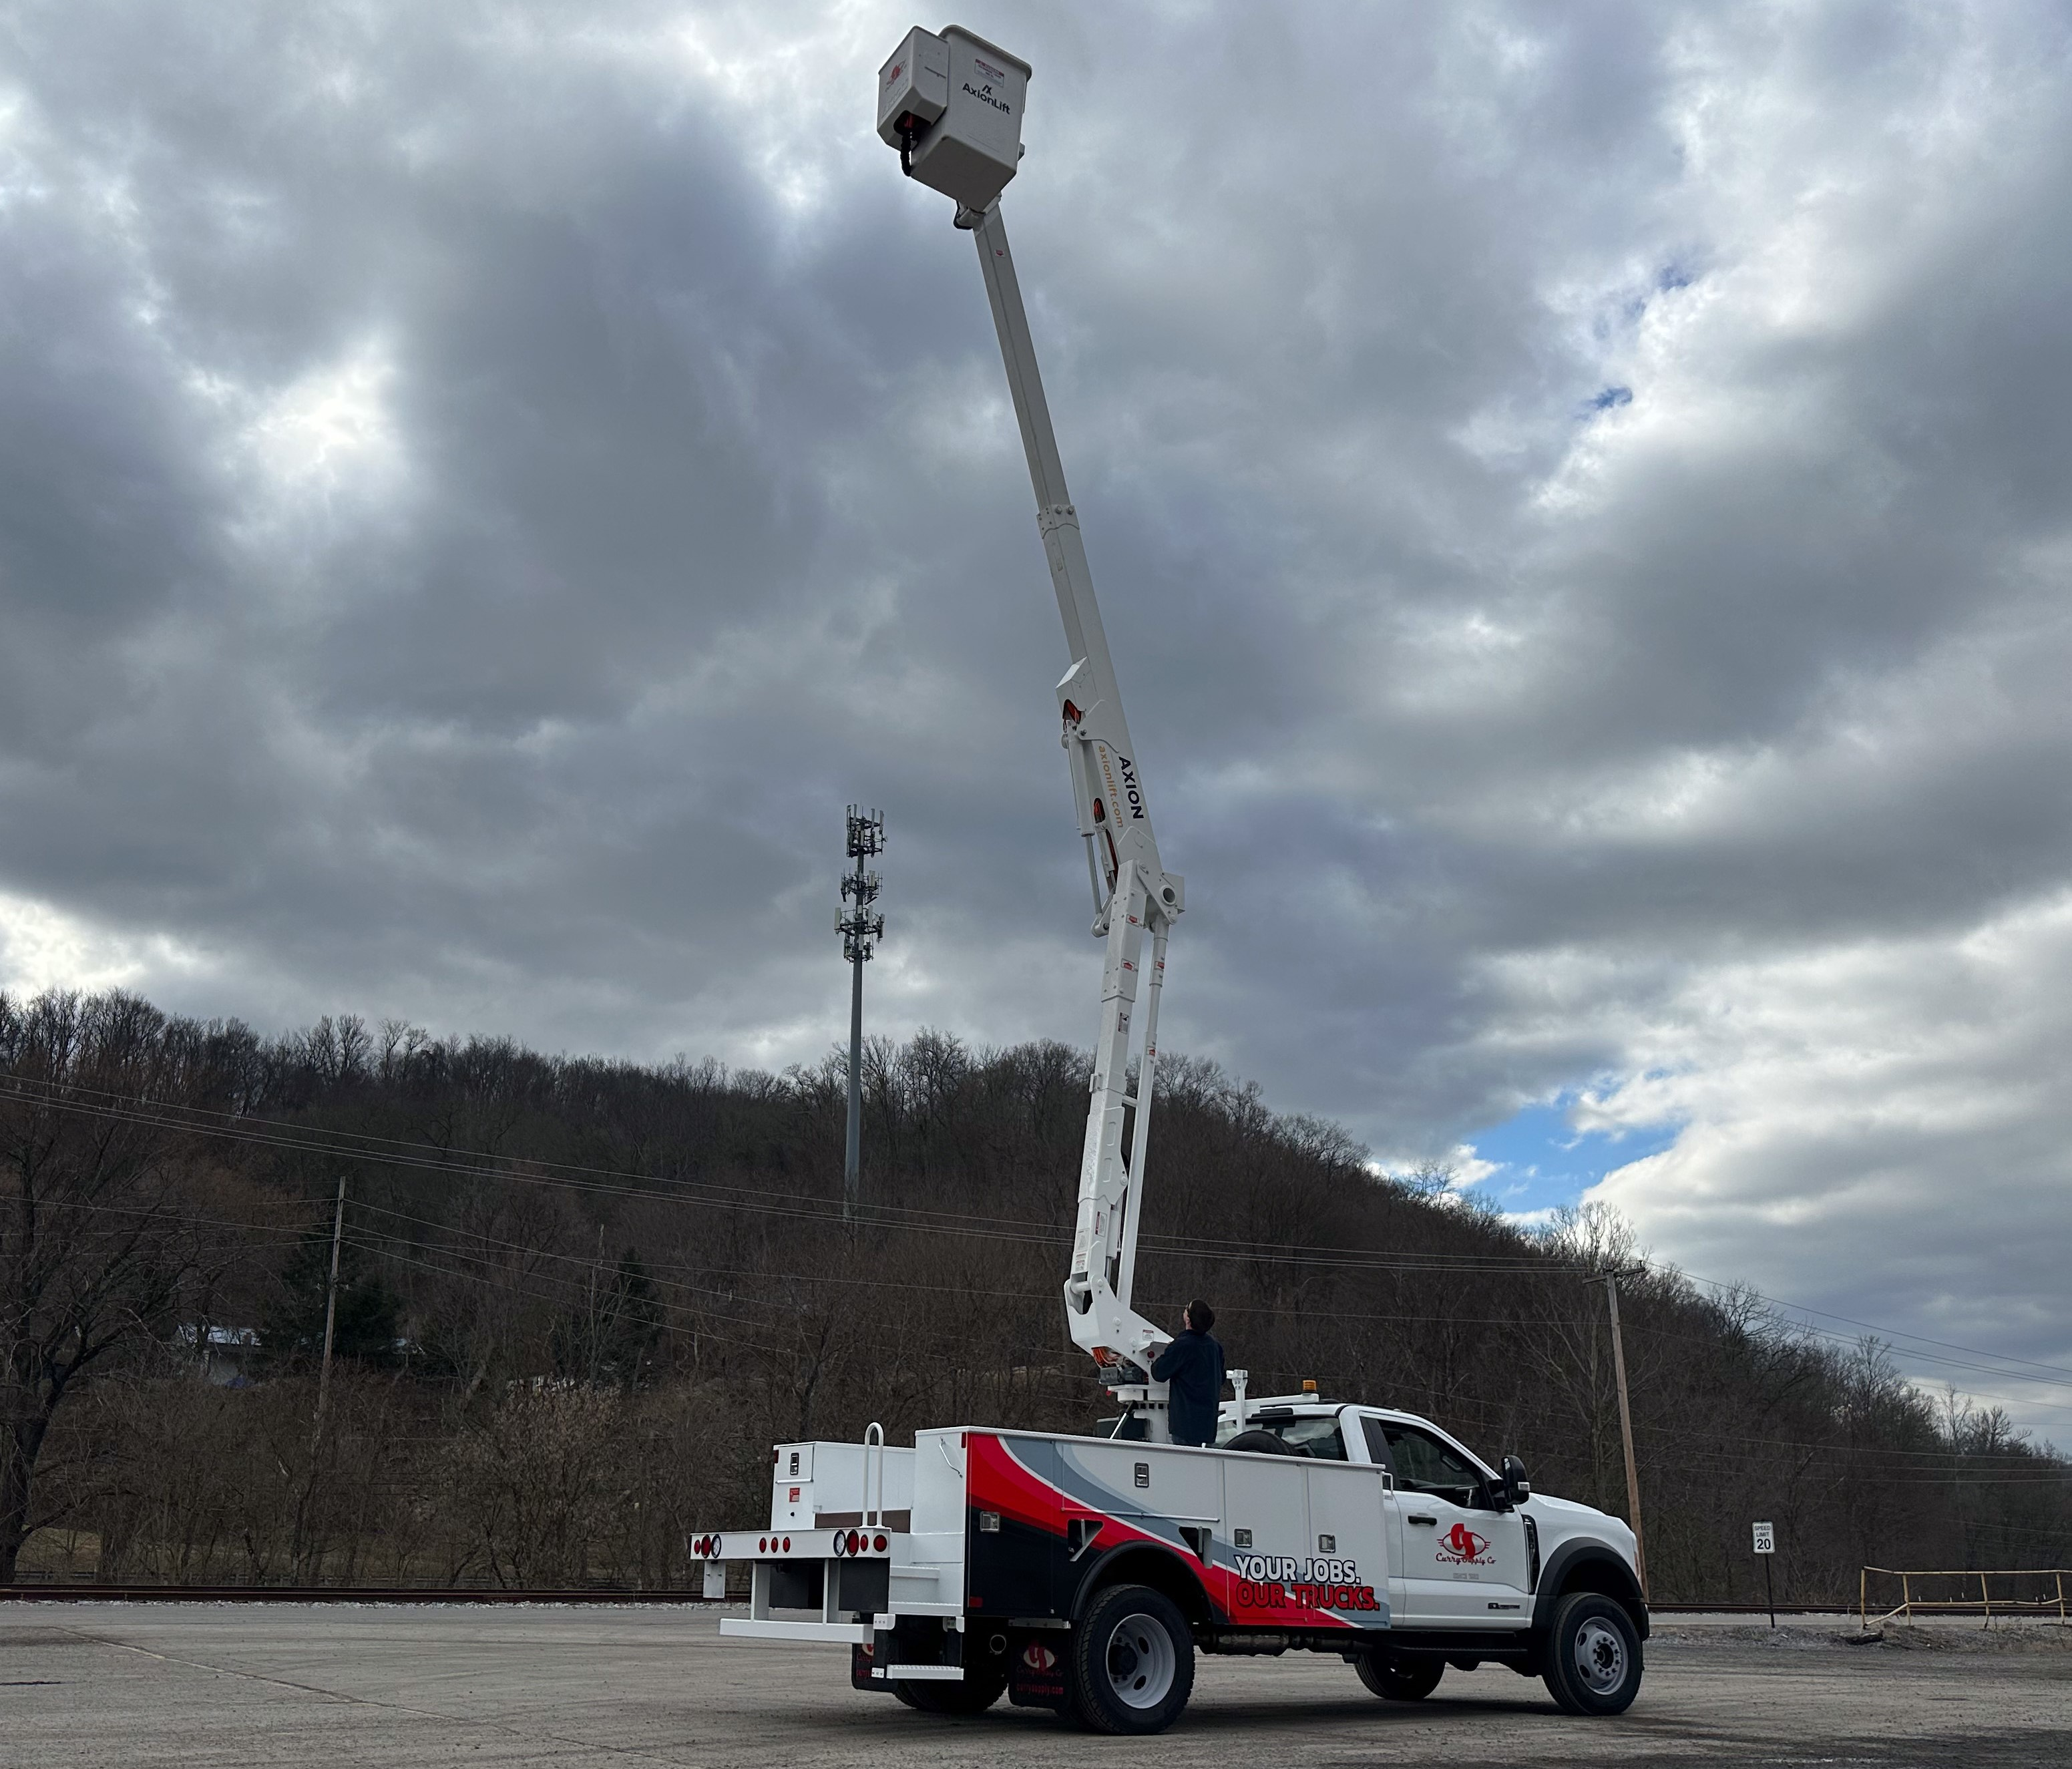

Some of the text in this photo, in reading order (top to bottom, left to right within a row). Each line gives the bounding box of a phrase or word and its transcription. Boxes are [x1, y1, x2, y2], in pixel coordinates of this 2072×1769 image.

[962, 82, 1010, 115] AxionLift
[1098, 745, 1123, 828] axionlift.com
[1118, 756, 1145, 819] AXION
[1436, 1553, 1461, 1565] Curry
[1757, 1539, 1771, 1549] 20
[1234, 1555, 1362, 1585] YOUR JOBS.
[1236, 1581, 1380, 1611] OUR TRUCKS.
